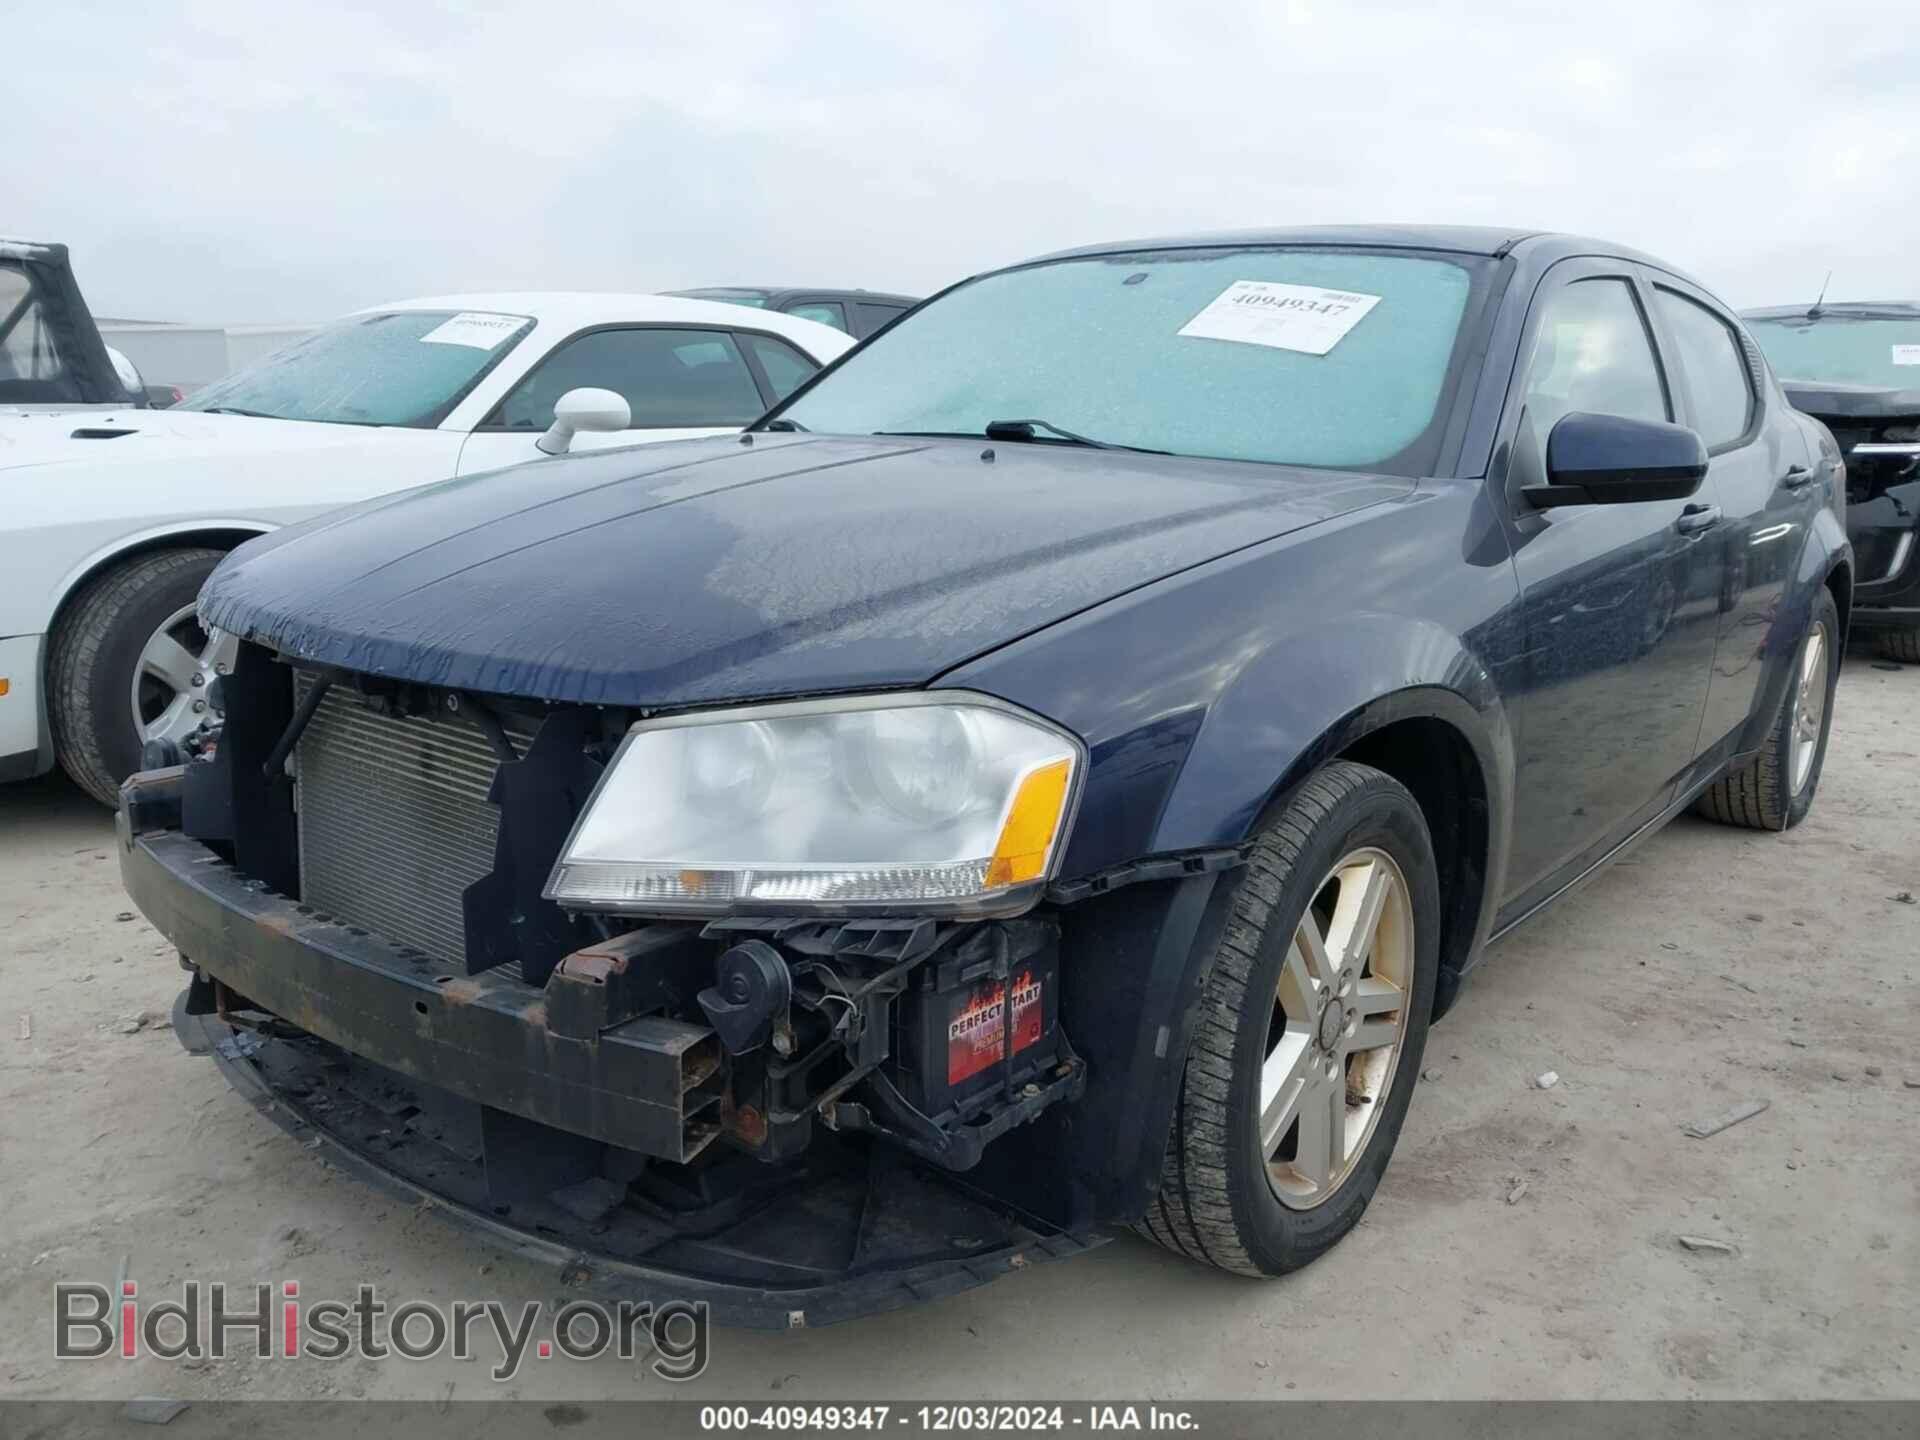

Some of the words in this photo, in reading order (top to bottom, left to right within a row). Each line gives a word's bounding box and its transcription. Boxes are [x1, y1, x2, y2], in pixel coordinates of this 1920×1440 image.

[1232, 293, 1350, 316] 40949347
[950, 1003, 1003, 1037] PERFECT
[1011, 986, 1040, 1008] TART
